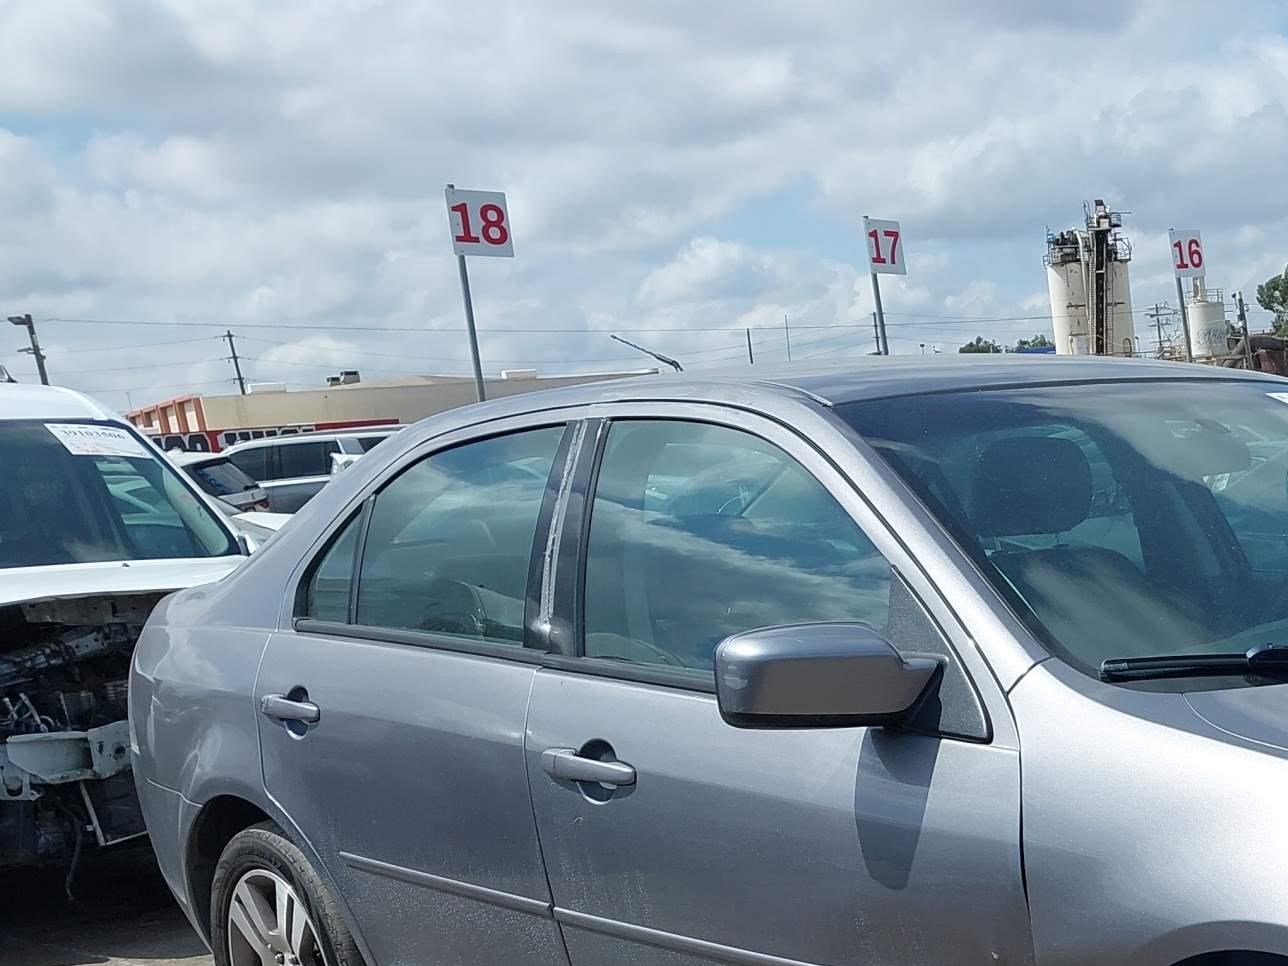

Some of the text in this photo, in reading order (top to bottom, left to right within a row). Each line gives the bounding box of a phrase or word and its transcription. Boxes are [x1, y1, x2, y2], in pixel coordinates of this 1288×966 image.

[451, 202, 508, 245] 18
[868, 229, 899, 264] 17
[1173, 238, 1203, 269] 16
